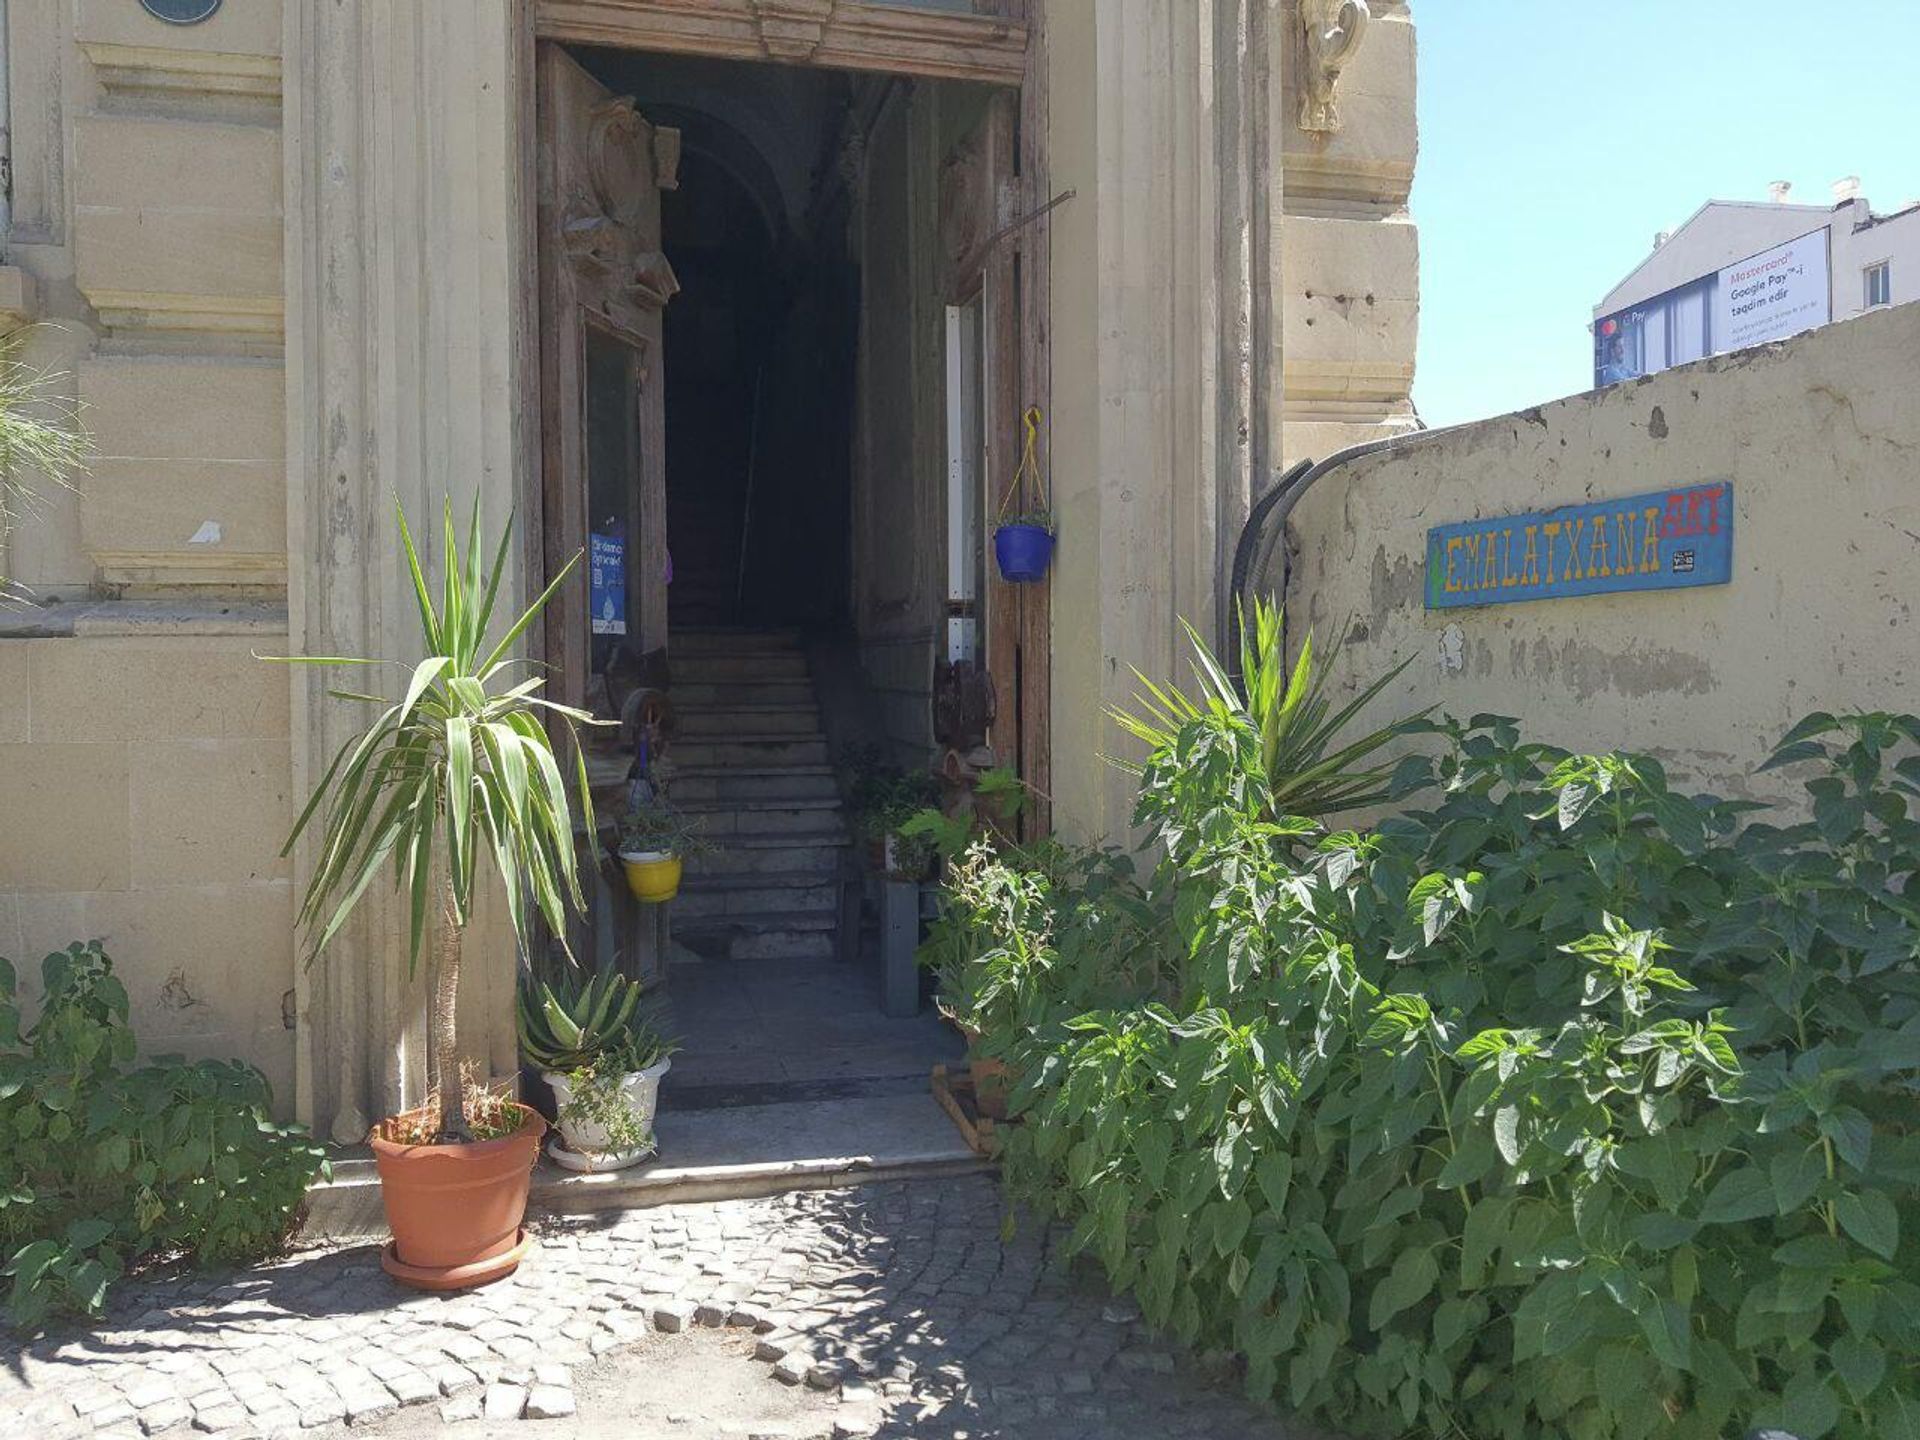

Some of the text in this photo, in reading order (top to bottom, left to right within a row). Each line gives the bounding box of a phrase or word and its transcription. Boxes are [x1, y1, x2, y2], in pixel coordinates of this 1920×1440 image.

[1731, 280, 1766, 300] Google
[1768, 288, 1789, 303] edir
[1632, 311, 1646, 323] Pay
[1445, 487, 1723, 592] EMALATXANA ART
